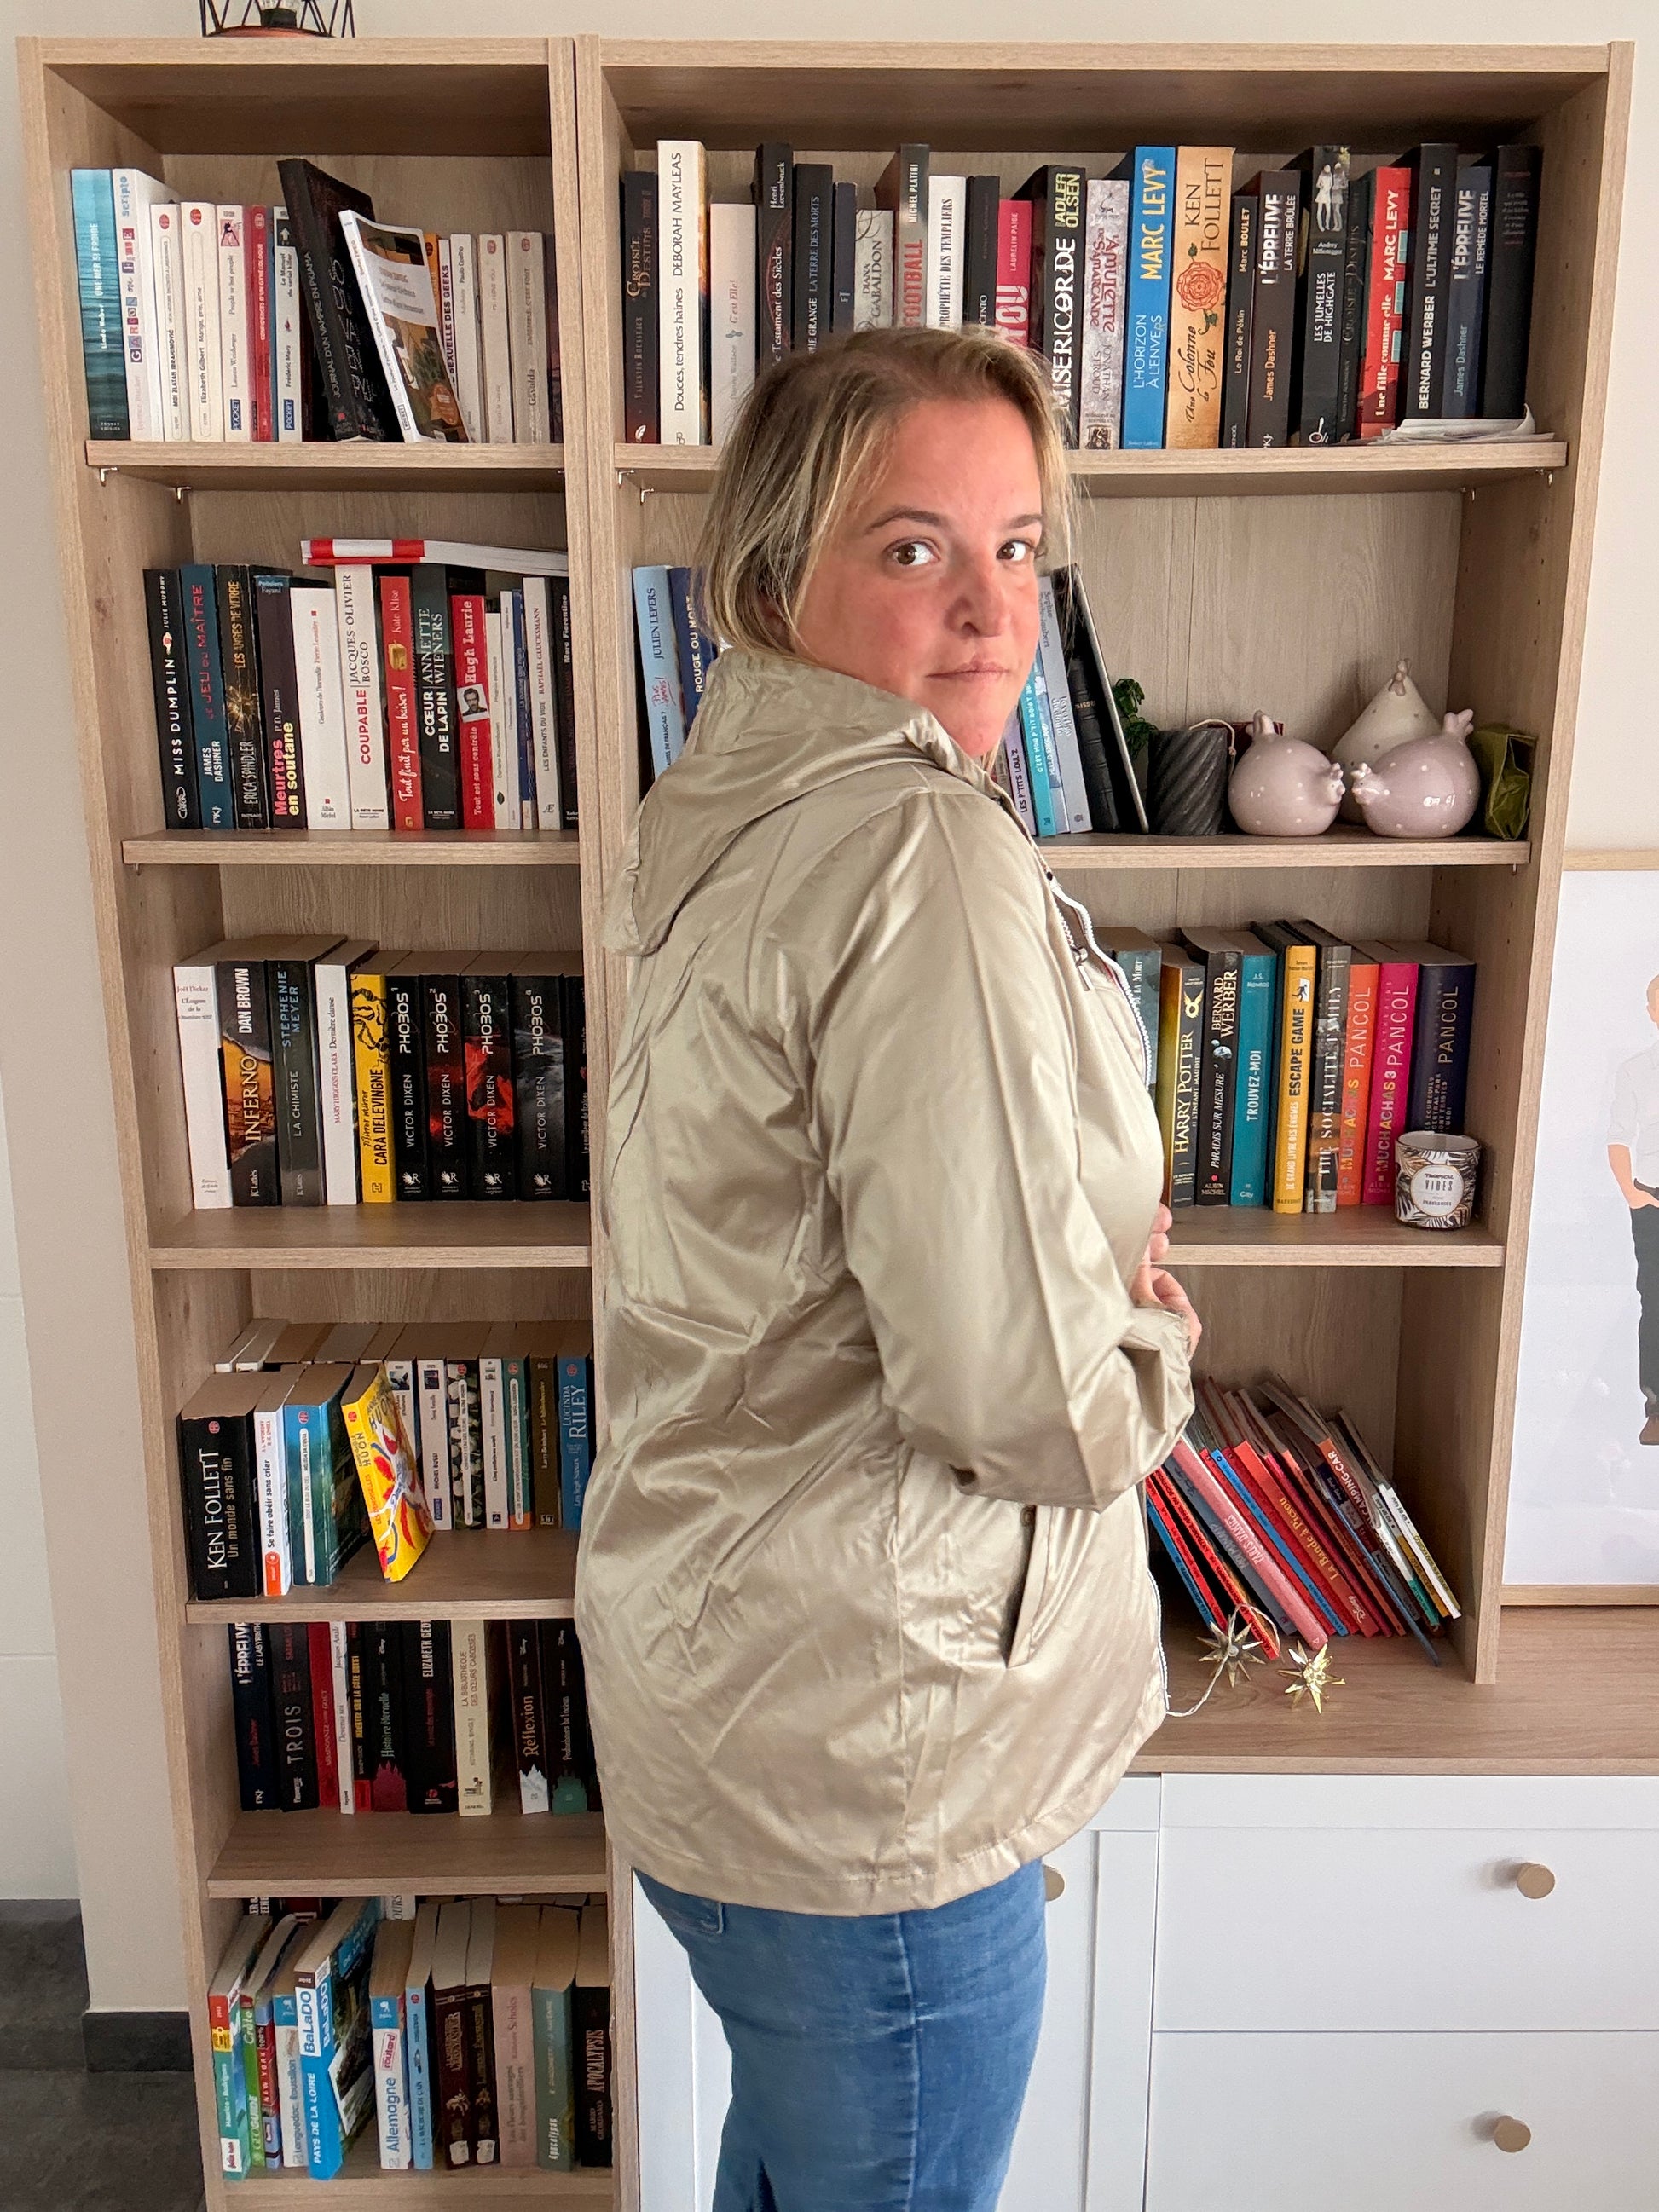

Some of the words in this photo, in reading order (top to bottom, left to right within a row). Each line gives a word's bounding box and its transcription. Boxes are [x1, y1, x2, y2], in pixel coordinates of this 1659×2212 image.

[671, 153, 682, 213] MAYLEAS
[1066, 174, 1080, 228] OLSEN
[1142, 165, 1166, 215] LEVY
[1185, 184, 1201, 227] KEN
[1202, 157, 1224, 251] FOLLETT
[1385, 189, 1399, 230] LEVY
[1429, 186, 1442, 230] SECRET
[672, 217, 682, 277] DEBORAH
[1139, 223, 1165, 280] MARC
[1258, 194, 1283, 285] L'ÉPREUVE
[1452, 189, 1473, 280] L'ÉPREUVE
[303, 252, 317, 287] PYJAMA
[457, 268, 465, 284] Paulo
[772, 246, 783, 280] Siècles
[1383, 234, 1396, 280] MARC
[1425, 232, 1439, 287] L'ULTIME
[310, 287, 320, 298] EN
[772, 282, 782, 298] des
[862, 263, 870, 295] DIANA
[871, 240, 882, 318] GABALDON
[904, 239, 922, 328] FOOTBALL
[1315, 273, 1327, 322] JUMELLES
[314, 300, 327, 335] VAMPIRE
[673, 288, 684, 324] haines
[1323, 271, 1337, 328] HIGHGATE
[772, 301, 783, 353] Testament
[1314, 324, 1324, 342] LES
[1323, 329, 1333, 343] DE
[1422, 295, 1436, 349] WERBER
[198, 347, 206, 372] Gilbert
[322, 336, 332, 357] D'UN
[673, 326, 684, 367] tendres
[1132, 314, 1147, 389] L'HORIZON
[1265, 329, 1277, 369] Dashner
[1455, 324, 1468, 364] Dashner
[199, 372, 208, 404] Elizabeth
[327, 357, 341, 399] JOURNAL
[527, 368, 537, 406] Gavalda
[674, 367, 685, 412] Douces,
[1264, 372, 1275, 401] James
[1419, 350, 1432, 410] BERNARD
[1454, 365, 1465, 396] James
[460, 600, 474, 644] Laurie
[647, 587, 660, 624] LEPERS
[342, 574, 360, 684] JACQUES-OLIVIER
[418, 608, 433, 684] ANNETTE
[431, 613, 446, 684] WIENERS
[533, 607, 545, 660] GLUCKSMANN
[651, 626, 665, 660] JULIEN
[689, 632, 699, 649] OU
[360, 641, 370, 683] BOSCO
[463, 648, 479, 684] Hugh
[535, 661, 546, 695] RAPHAËL
[692, 653, 704, 693] ROUGE
[165, 658, 181, 733] DUMPLIN
[423, 690, 435, 736] CŒUR
[436, 690, 448, 731] LAPIN
[356, 690, 371, 765] COUPABLE
[440, 735, 450, 753] DE
[171, 738, 185, 776] MISS
[203, 747, 213, 776] JAMES
[211, 740, 223, 783] DASHNER
[281, 723, 298, 790] soutane
[1011, 748, 1022, 774] LOUL'Z
[271, 739, 288, 816] Meurtres
[1014, 775, 1026, 798] P'TITS
[288, 794, 299, 816] en
[1018, 800, 1028, 813] LES
[234, 968, 251, 1008] BROWN
[1211, 977, 1223, 1031] BERNARD
[1222, 970, 1238, 1038] WERBER
[237, 1011, 253, 1034] DAN
[277, 970, 291, 1048] STEPHENIE
[289, 985, 300, 1033] MEYER
[396, 993, 411, 1054] PHOBOS
[435, 993, 450, 1054] PHOBOS
[479, 993, 494, 1054] PHOBOS
[529, 995, 544, 1054] PHOBOS
[1289, 1008, 1304, 1045] GAME
[1325, 985, 1342, 1042] FAMILY
[1350, 987, 1371, 1068] PANCOL
[1386, 985, 1409, 1066] PANCOL
[1437, 986, 1459, 1064] PANCOL
[1176, 1030, 1194, 1094] POTTER
[1287, 1048, 1303, 1097] ESCAPE
[1384, 1071, 1397, 1079] 3
[242, 1055, 262, 1142] INFERNO
[290, 1071, 300, 1118] CHIMISTE
[370, 1069, 385, 1135] DELEVINGNE
[402, 1074, 413, 1106] DIXEN
[442, 1074, 452, 1106] DIXEN
[486, 1074, 496, 1106] DIXEN
[535, 1074, 546, 1106] DIXEN
[1213, 1073, 1224, 1111] MESURE
[1246, 1050, 1262, 1122] TROUVEZ-MOI
[1320, 1051, 1338, 1139] SOCIALITE
[293, 1123, 302, 1137] LA
[404, 1110, 415, 1148] VICTOR
[443, 1110, 454, 1148] VICTOR
[486, 1112, 498, 1148] VICTOR
[537, 1112, 547, 1148] VICTOR
[1174, 1098, 1192, 1153] HARRY
[1212, 1112, 1223, 1130] SUR
[1287, 1101, 1299, 1129] ÉNIGMES
[1288, 1129, 1298, 1141] DES
[1341, 1079, 1360, 1170] MUCHACHAS
[1374, 1081, 1396, 1173] MUCHACHAS
[373, 1137, 388, 1166] CARA
[1211, 1132, 1222, 1168] PARADIS
[1287, 1142, 1298, 1159] LIVRE
[1318, 1146, 1332, 1176] THE
[1286, 1161, 1298, 1181] GRAND
[1425, 1180, 1453, 1192] VIBES
[569, 1384, 587, 1439] RILEY
[199, 1447, 223, 1524] FOLLETT
[263, 1459, 272, 1478] crier
[264, 1498, 274, 1518] obéir
[1278, 1497, 1302, 1531] Picsou
[264, 1520, 275, 1538] faire
[268, 1539, 275, 1548] Se
[206, 1531, 228, 1569] KEN
[1308, 1535, 1327, 1566] Bande
[1327, 1566, 1339, 1580] La
[421, 1639, 434, 1678] ELIZABETH
[467, 1633, 477, 1667] CABOSSÉS
[459, 1651, 469, 1696] BIBLIOTHÈQUE
[378, 1692, 390, 1725] éternelle
[461, 1698, 469, 1707] LA
[471, 1695, 479, 1707] DES
[284, 1705, 303, 1764] TROIS
[379, 1725, 395, 1758] Histoire
[520, 1695, 540, 1756] Réflexion
[257, 2027, 266, 2048] 100%
[300, 1991, 315, 2053] BaLaDO
[258, 2051, 268, 2077] YORK
[587, 2029, 605, 2093] APOCALYPSIS
[261, 2082, 270, 2103] NEW
[384, 2077, 401, 2153] Allemagne
[547, 2118, 559, 2161] Apocalypse
